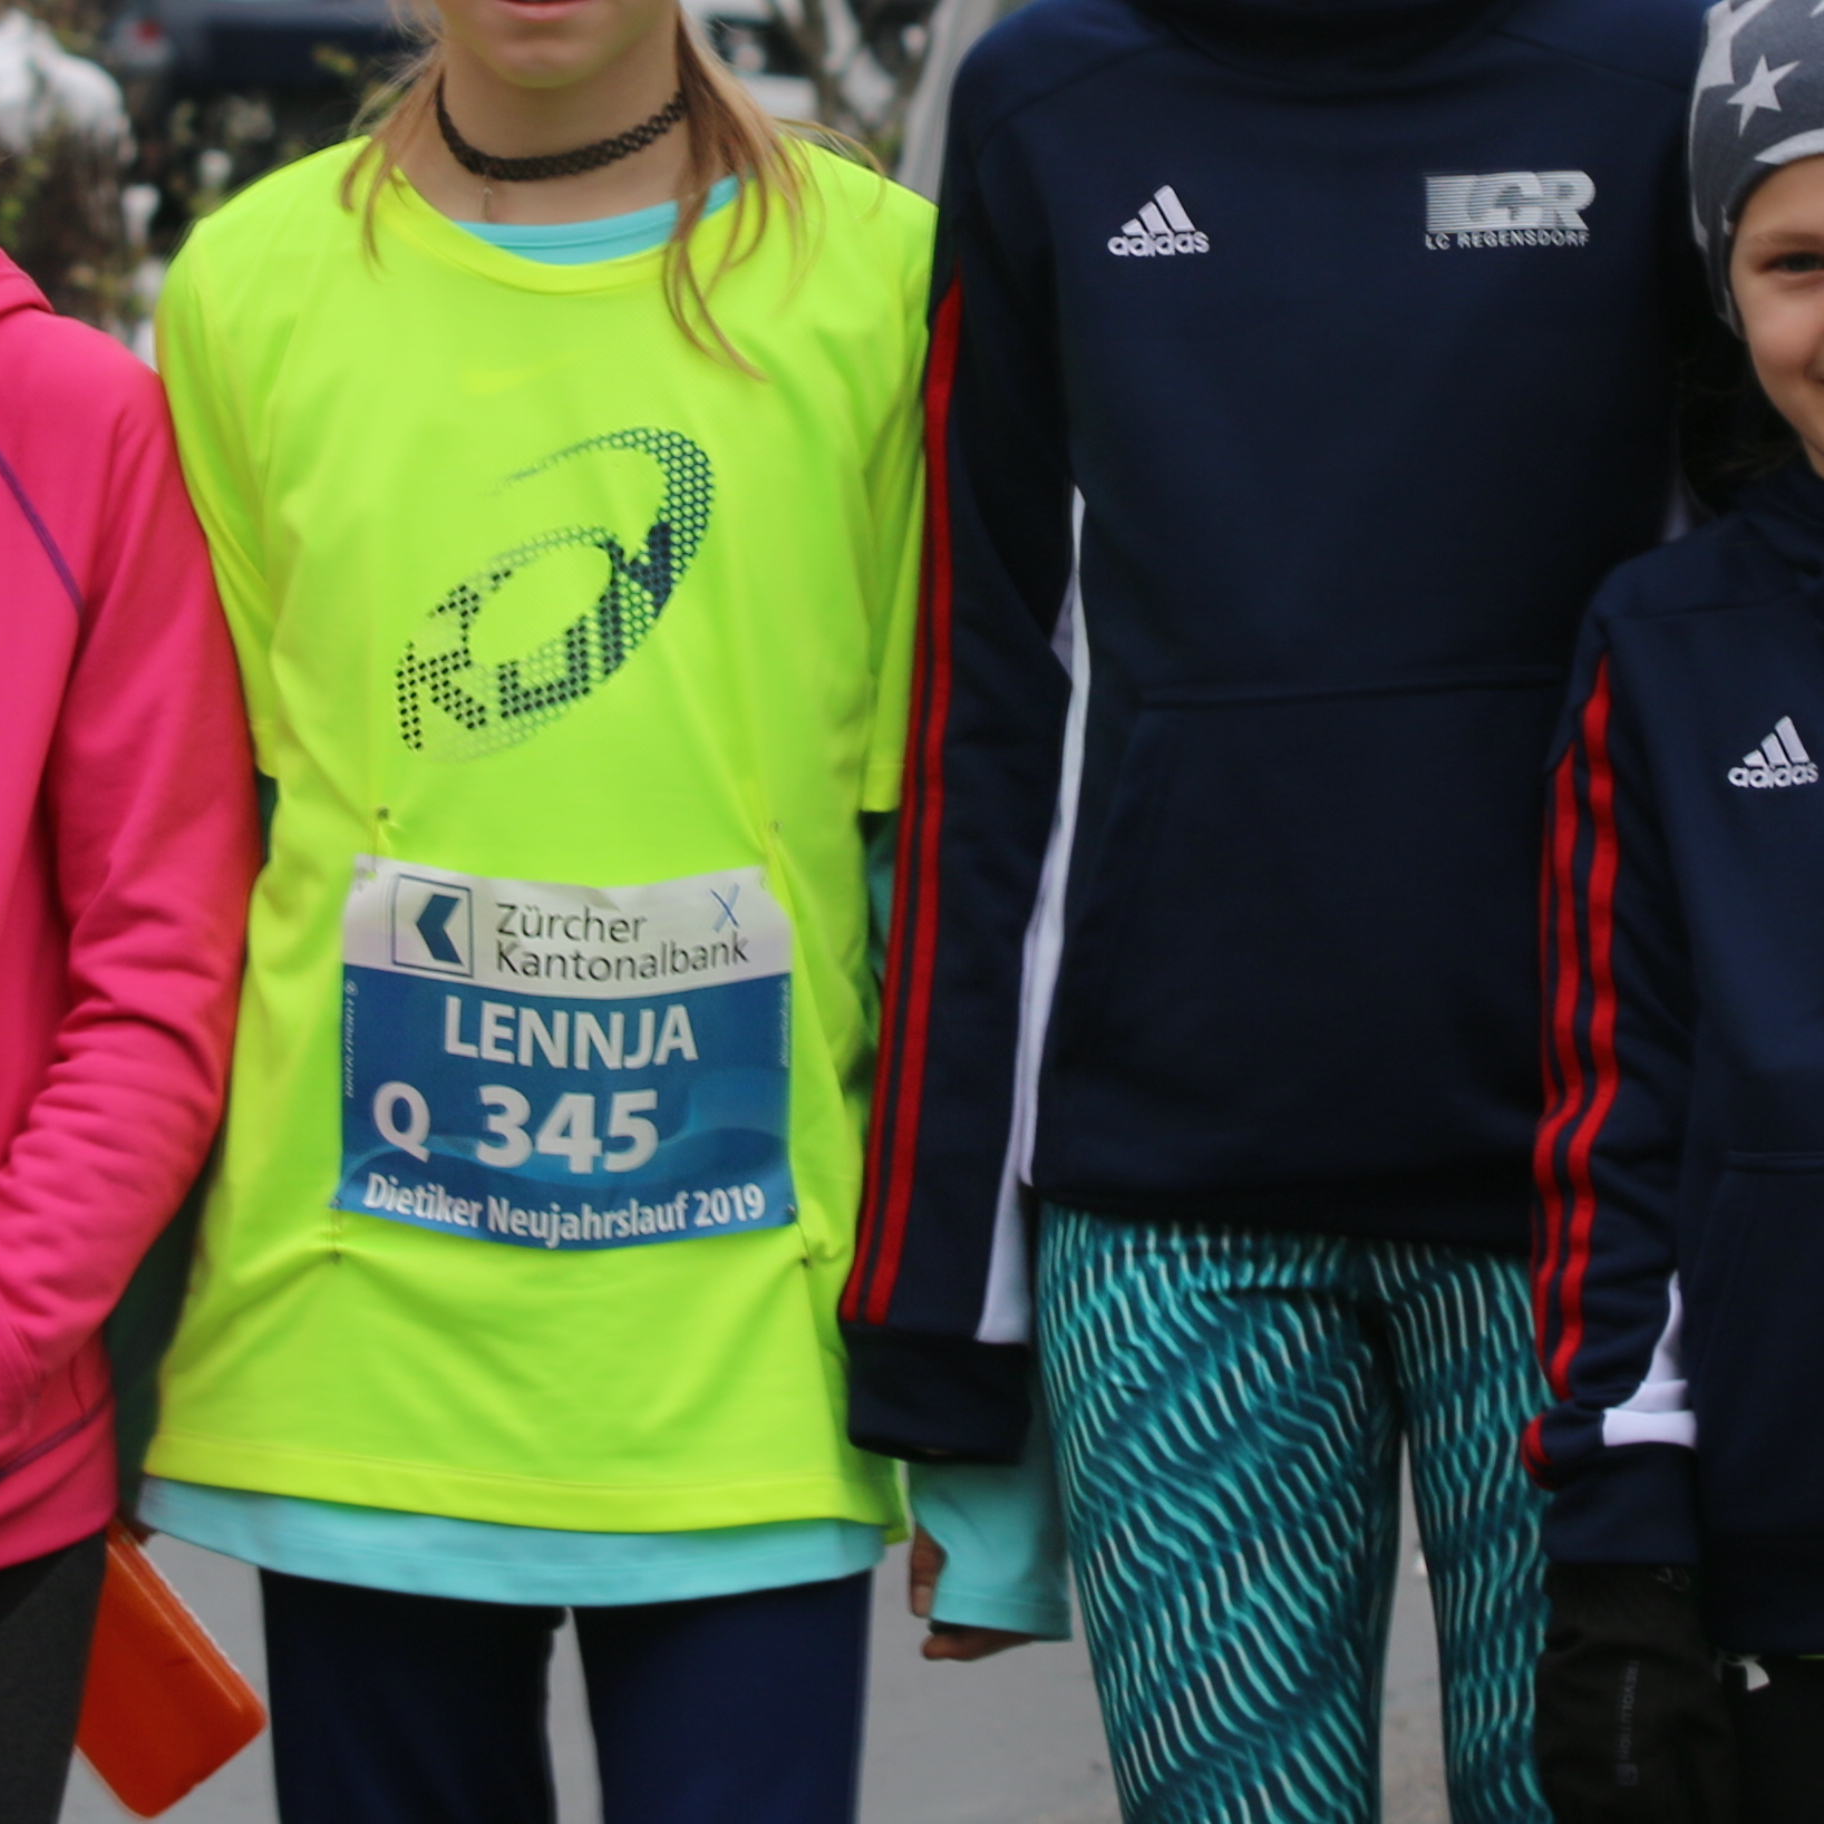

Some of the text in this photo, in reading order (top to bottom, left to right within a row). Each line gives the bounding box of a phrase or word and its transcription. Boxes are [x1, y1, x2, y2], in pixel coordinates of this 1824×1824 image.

[1107, 231, 1210, 257] adidas
[1425, 229, 1590, 250] LC REGENSDORF
[1728, 762, 1819, 788] adidas
[496, 902, 648, 944] Zürcher
[496, 931, 749, 982] Kantonalbank
[444, 994, 699, 1070] LENNJA
[373, 1080, 659, 1174] Q 345
[363, 1172, 766, 1249] Dietiker Neujahrslauf 2019
